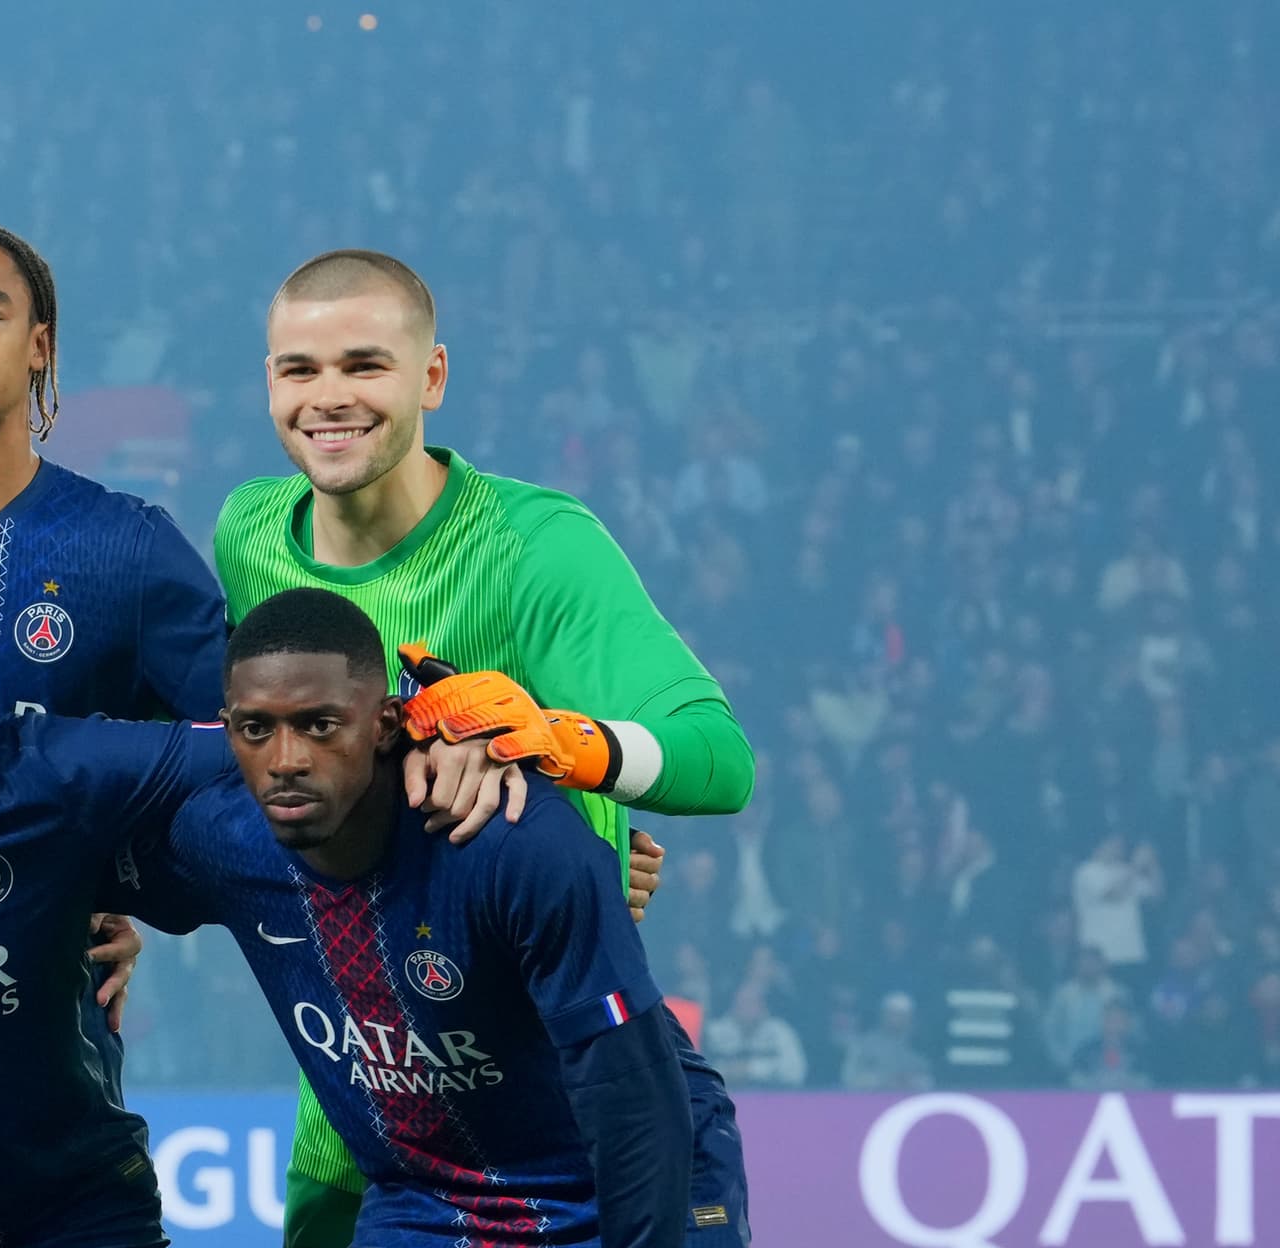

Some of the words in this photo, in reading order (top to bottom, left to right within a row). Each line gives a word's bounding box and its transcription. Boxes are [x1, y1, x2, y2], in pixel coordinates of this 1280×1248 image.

[27, 606, 66, 623] PARIS
[410, 952, 446, 966] PARIS
[293, 1001, 493, 1068] QATAR
[350, 1060, 504, 1094] AIRWAYS
